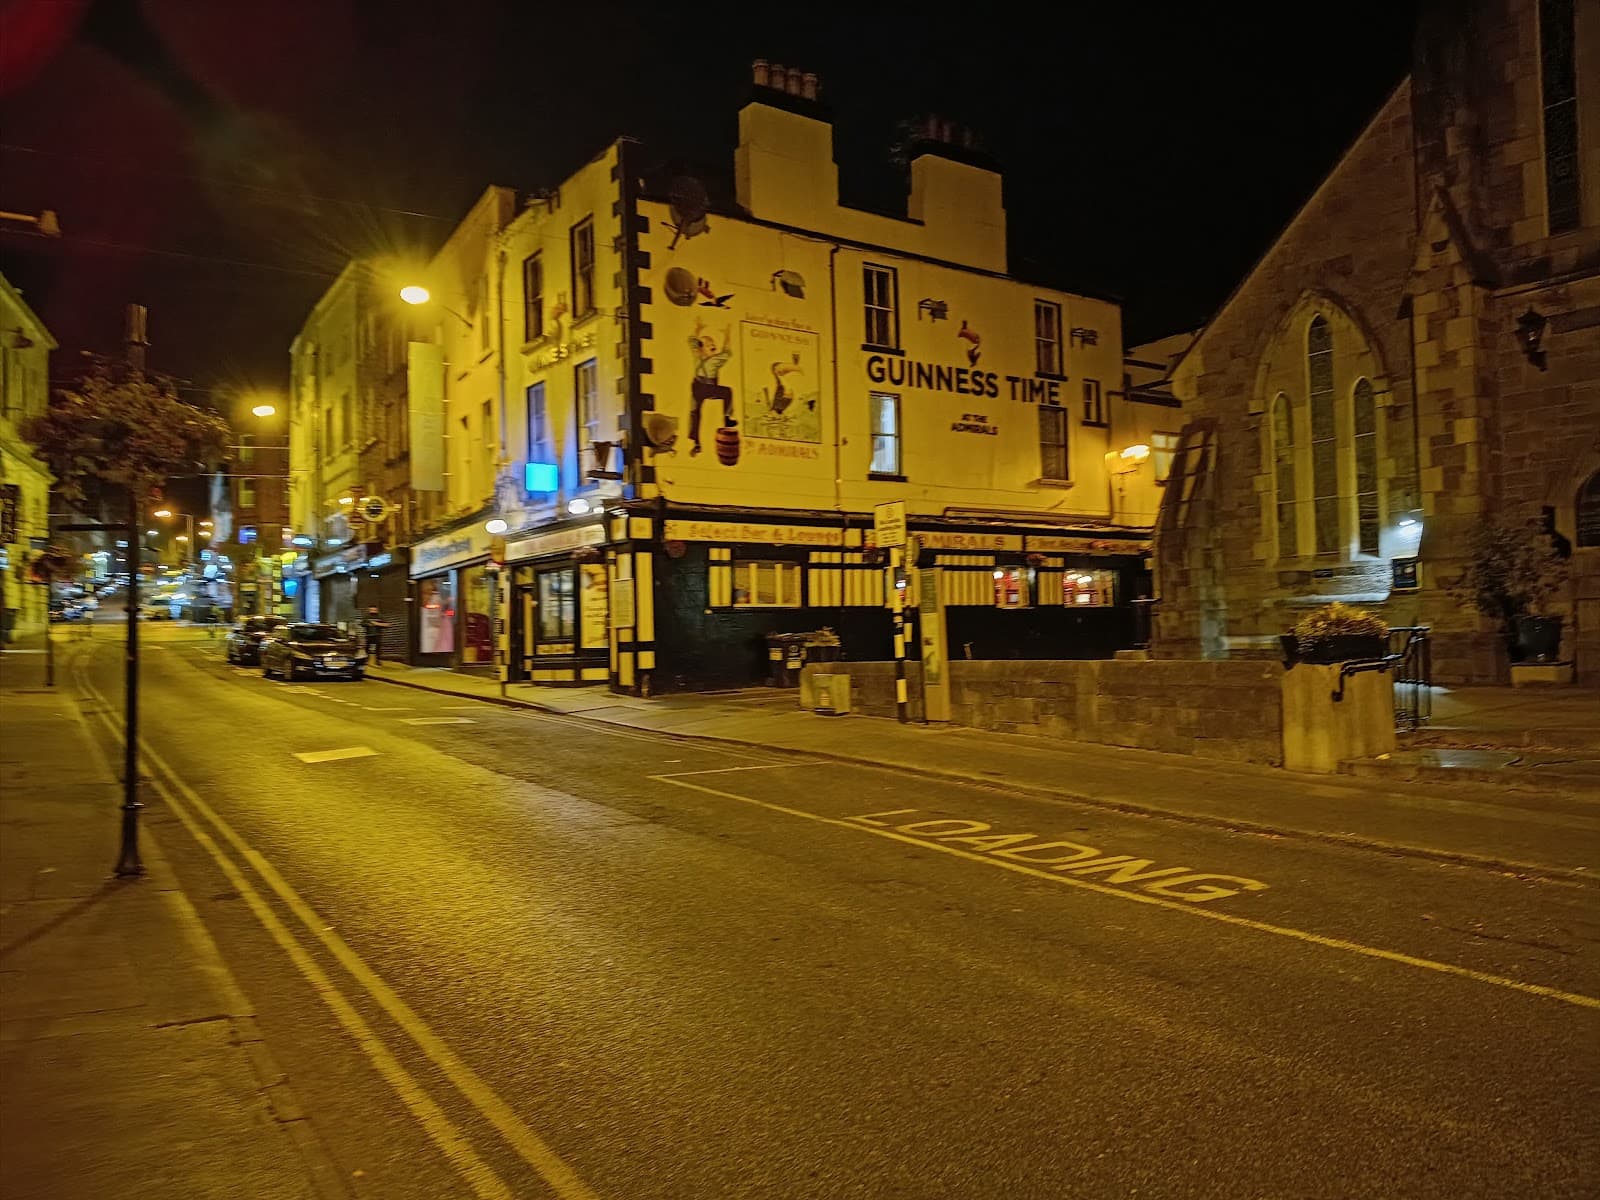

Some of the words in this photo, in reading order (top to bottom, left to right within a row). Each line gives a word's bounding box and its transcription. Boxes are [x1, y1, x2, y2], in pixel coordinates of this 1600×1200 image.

[867, 355, 999, 398] GUINNESS
[1005, 375, 1060, 406] TIME
[951, 422, 999, 436] ADMIRALS
[743, 525, 767, 541] Bar
[844, 809, 1269, 902] LOADING
